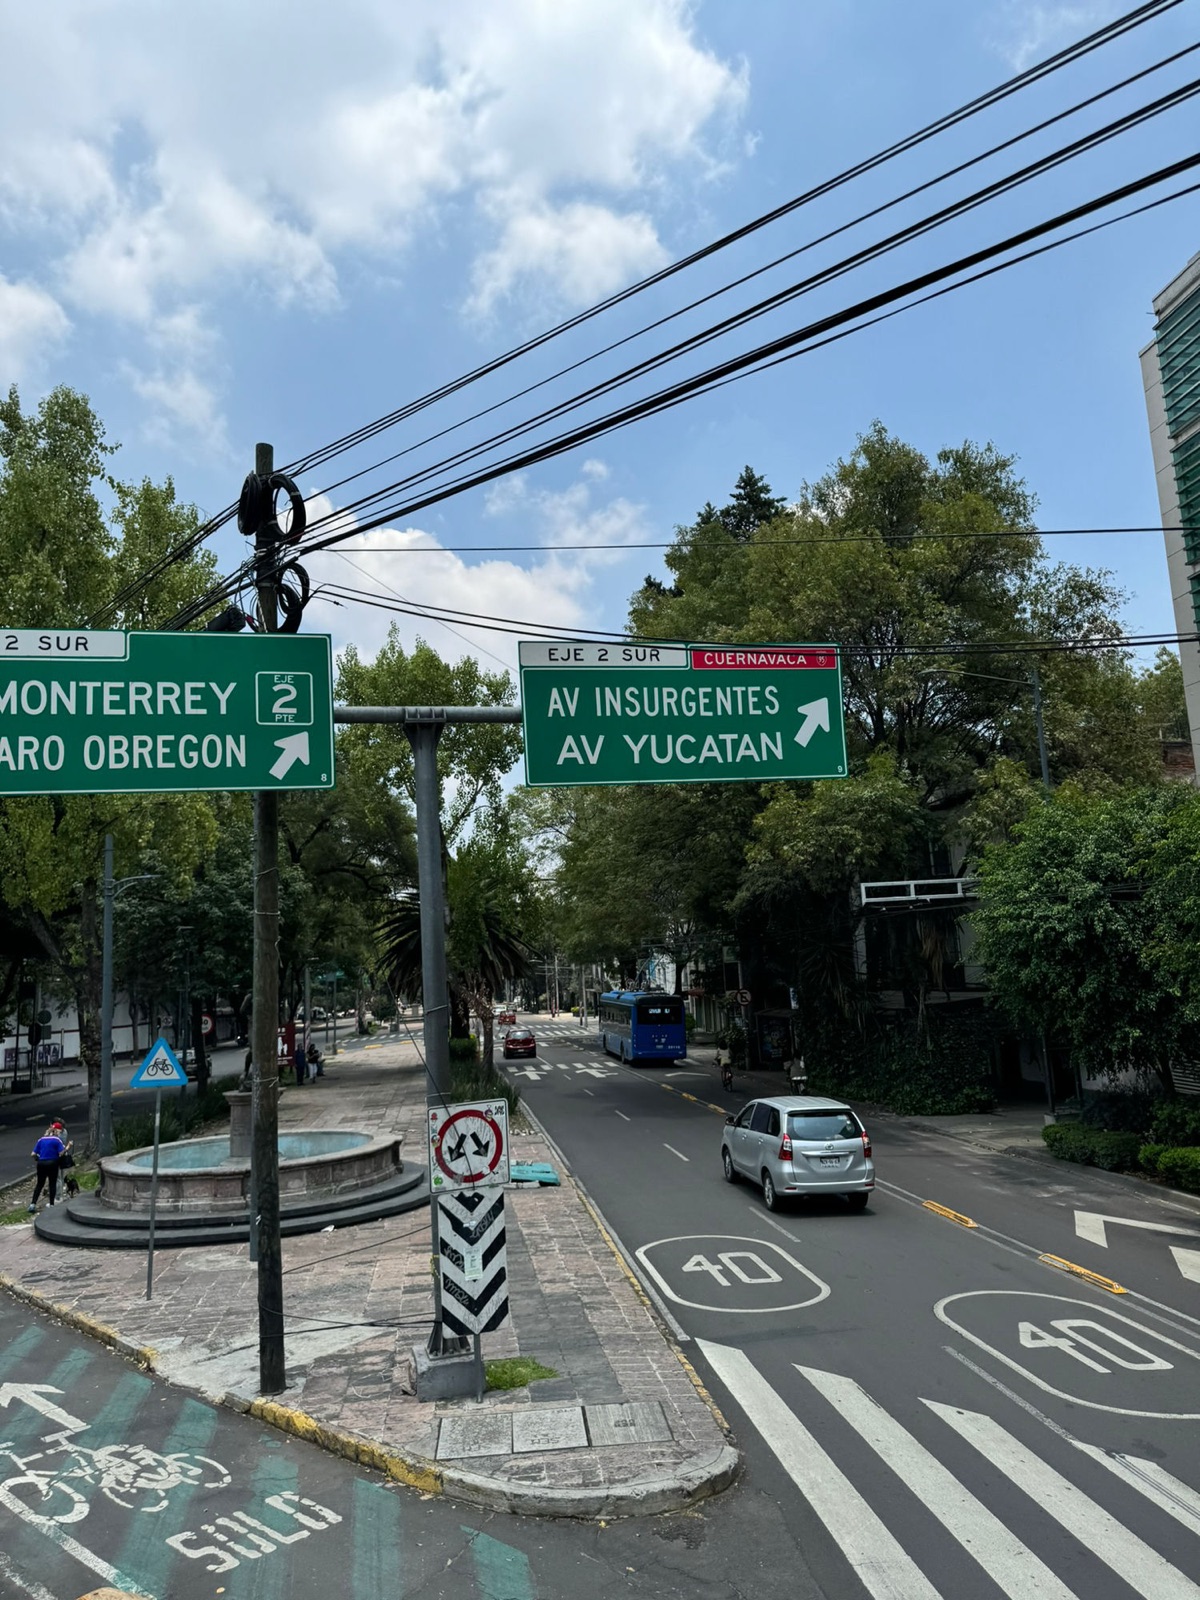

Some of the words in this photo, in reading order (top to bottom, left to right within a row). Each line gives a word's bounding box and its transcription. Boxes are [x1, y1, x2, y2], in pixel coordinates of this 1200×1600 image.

[5, 635, 19, 651] 2
[37, 635, 89, 651] SUR
[548, 648, 584, 662] EJE
[597, 648, 609, 662] 2
[622, 648, 660, 662] SUR
[704, 652, 807, 666] CUERNAVACA
[274, 675, 294, 684] EJE
[0, 680, 237, 716] MONTERREY
[272, 683, 298, 714] 2
[547, 687, 580, 717] AV
[595, 685, 780, 717] INSURGENTES
[274, 714, 295, 723] PTE
[83, 734, 247, 769] OBREGON
[556, 735, 605, 765] AV
[622, 732, 784, 764] YUCATAN
[321, 773, 328, 783] 8
[837, 765, 844, 773] 9
[681, 1252, 783, 1287] 40
[1018, 1319, 1175, 1374] 40
